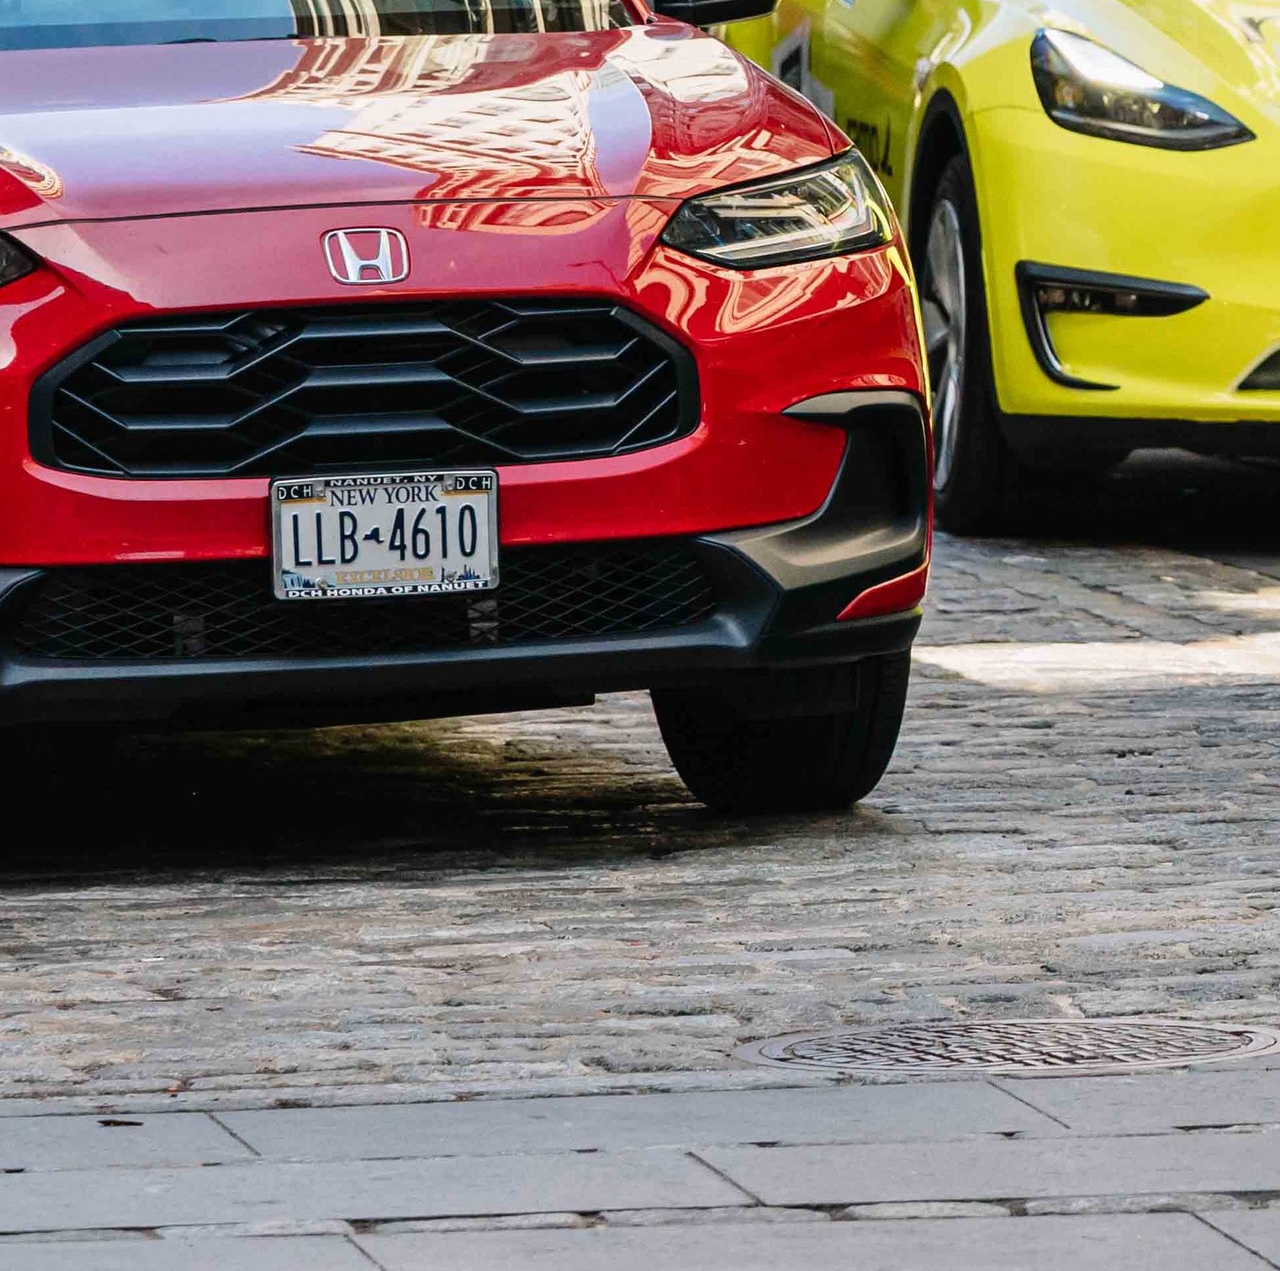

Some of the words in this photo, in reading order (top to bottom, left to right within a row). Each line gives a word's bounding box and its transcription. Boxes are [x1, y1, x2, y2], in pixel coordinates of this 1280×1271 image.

[330, 476, 409, 487] NANUET,
[456, 476, 491, 490] DCH
[278, 486, 313, 500] DCH
[329, 489, 376, 507] NEW
[385, 486, 439, 504] YORK
[292, 511, 359, 566] LLB
[388, 504, 478, 561] 4610
[288, 589, 323, 598] DCH
[327, 587, 387, 596] HONDA
[391, 586, 414, 594] OF
[418, 581, 486, 592] NANUET
